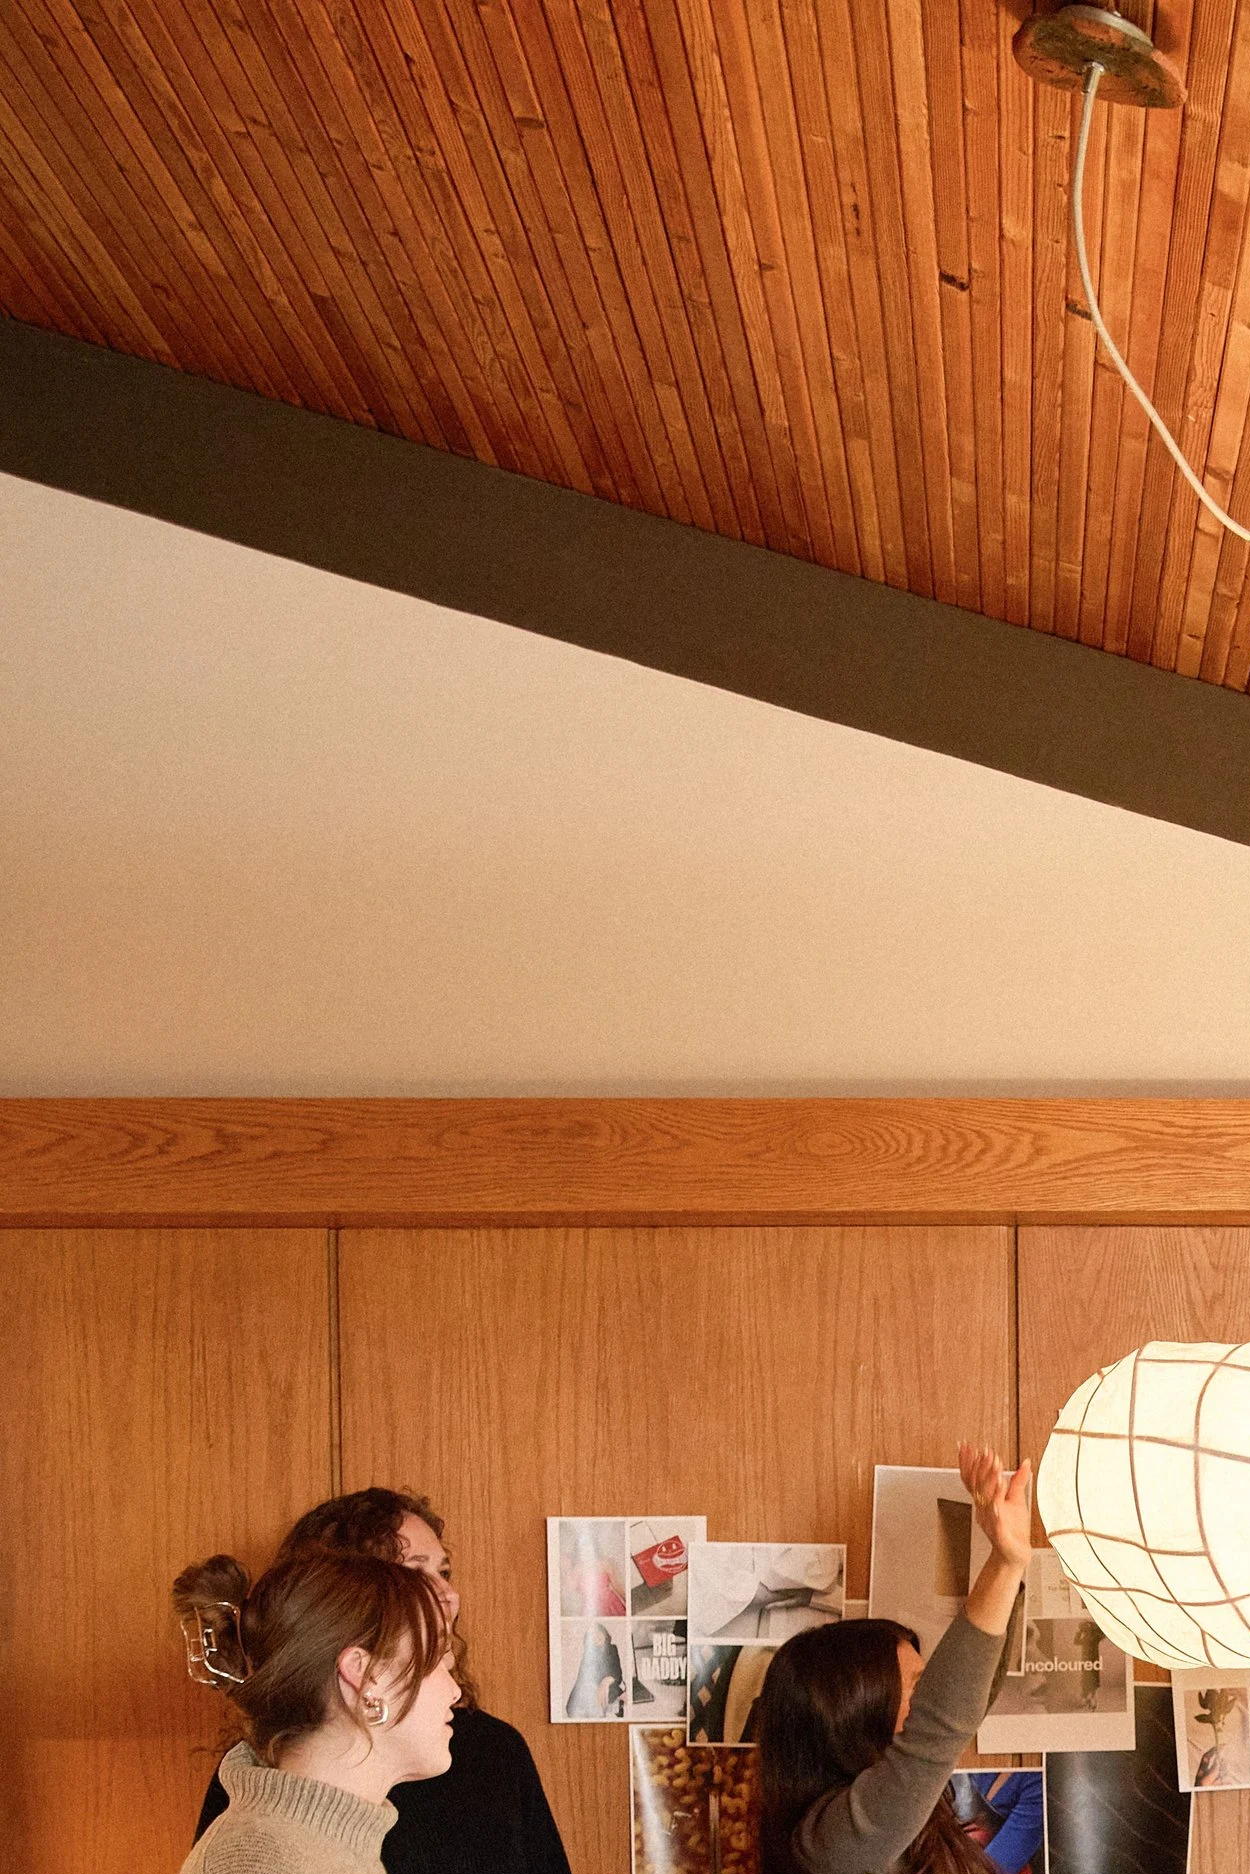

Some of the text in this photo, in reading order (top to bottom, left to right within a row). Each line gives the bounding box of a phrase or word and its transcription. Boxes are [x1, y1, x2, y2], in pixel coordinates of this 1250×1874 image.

[652, 1632, 676, 1657] BIG
[641, 1656, 687, 1680] DADDY
[1025, 1656, 1103, 1672] ncoloured
